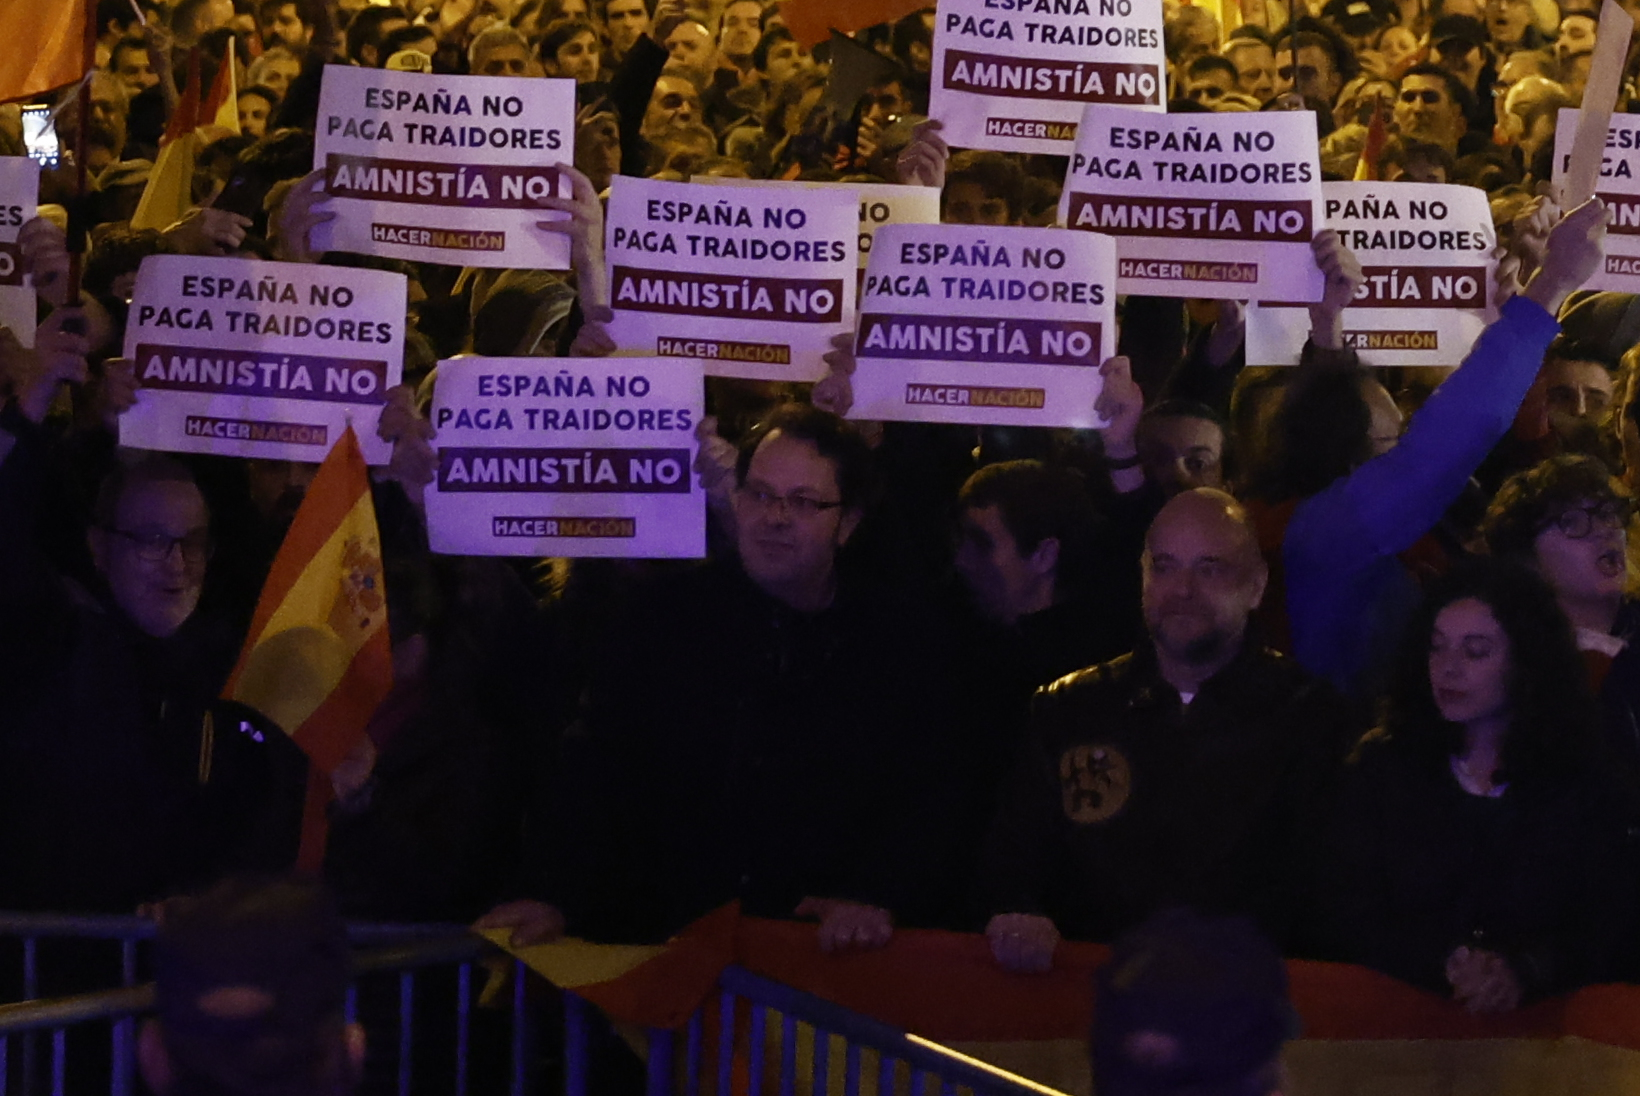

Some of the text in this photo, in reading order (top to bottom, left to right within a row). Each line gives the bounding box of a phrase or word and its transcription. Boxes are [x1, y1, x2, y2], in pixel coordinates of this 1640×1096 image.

[946, 14, 1158, 50] PAGA TRAIDORES
[951, 59, 1156, 98] AMNISTÍA NO
[366, 87, 523, 117] ESPAÑA NO
[328, 116, 561, 150] PAGA TRAIDORES
[986, 120, 1078, 140] HACERNA
[1109, 126, 1275, 153] ESPAÑA NO
[333, 159, 551, 202] AMNISTÍA NO
[1073, 152, 1312, 185] PAGA TRAIDORES
[647, 198, 806, 230] ESPAÑA NO
[1076, 196, 1304, 236] AMNISTÍA NO
[1325, 194, 1447, 221] PAÑA NO
[373, 224, 503, 251] HACERNACIÓN
[614, 226, 675, 254] PAGA
[687, 234, 846, 262] TRAIDORES
[1337, 228, 1487, 251] TRAIDORES
[901, 241, 1010, 268] ESPAÑA
[1022, 248, 1065, 270] NO
[1120, 259, 1257, 283] HACERNACIÓN
[182, 274, 353, 307] ESPAÑA NO
[616, 278, 836, 314] AMNISTÍA NO
[867, 274, 1105, 305] PAGA TRAIDORES
[1354, 269, 1478, 301] STÍA NO
[138, 306, 391, 344] PAGA TRAIDORES
[866, 316, 1091, 356] AMNISTÍA NO
[658, 339, 789, 364] HACERNACIÓN
[143, 352, 377, 396] AMNISTÍA NO
[478, 369, 650, 397] ESPAÑA NO
[906, 384, 1045, 407] HACERNACIÓN
[187, 416, 326, 445] HACERNACIÓN
[439, 407, 692, 432] PAGA TRAIDORES
[445, 449, 682, 485] AMNISTÍA NO
[495, 517, 633, 538] HACERNACIÓN
